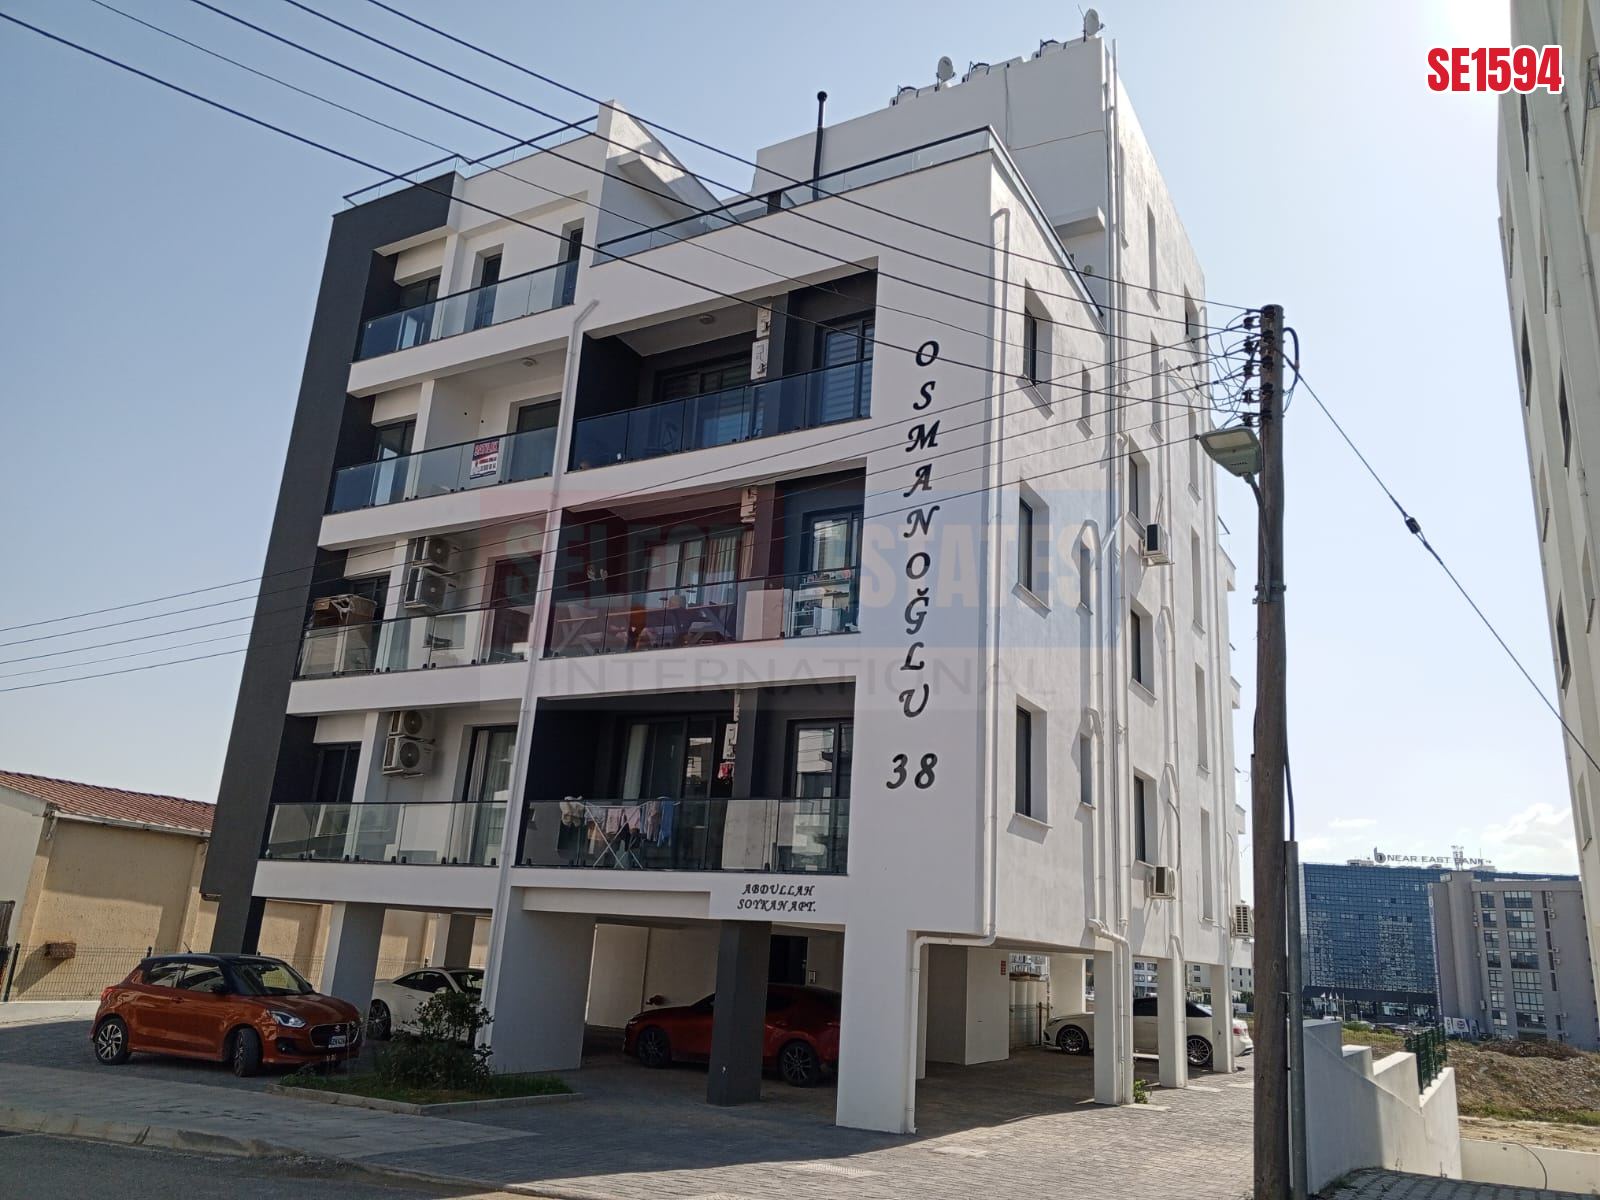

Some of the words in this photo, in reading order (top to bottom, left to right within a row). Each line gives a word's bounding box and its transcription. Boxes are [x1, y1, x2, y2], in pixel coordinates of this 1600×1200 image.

[886, 752, 938, 790] 38
[1387, 854, 1417, 863] NEAR
[1421, 855, 1450, 864] EAST
[742, 883, 815, 897] ABDULLAH
[737, 898, 788, 912] SOYKAN
